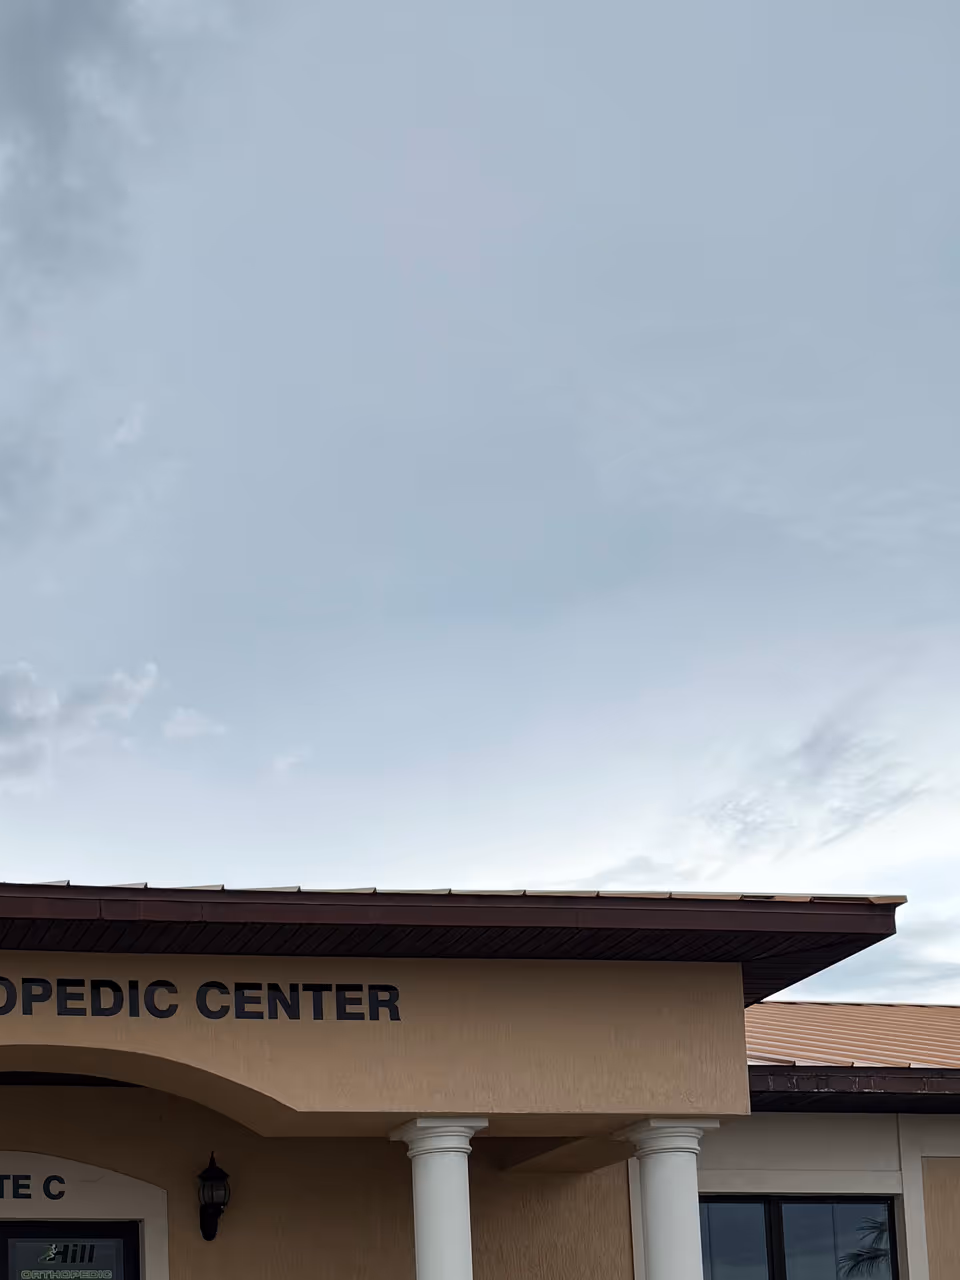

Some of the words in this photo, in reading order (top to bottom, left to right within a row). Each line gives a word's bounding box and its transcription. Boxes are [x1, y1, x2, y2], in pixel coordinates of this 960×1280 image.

[196, 981, 401, 1021] CENTER
[43, 1175, 66, 1200] C
[46, 1244, 95, 1263] Hill
[21, 1270, 112, 1279] ORTHOPEDIC
